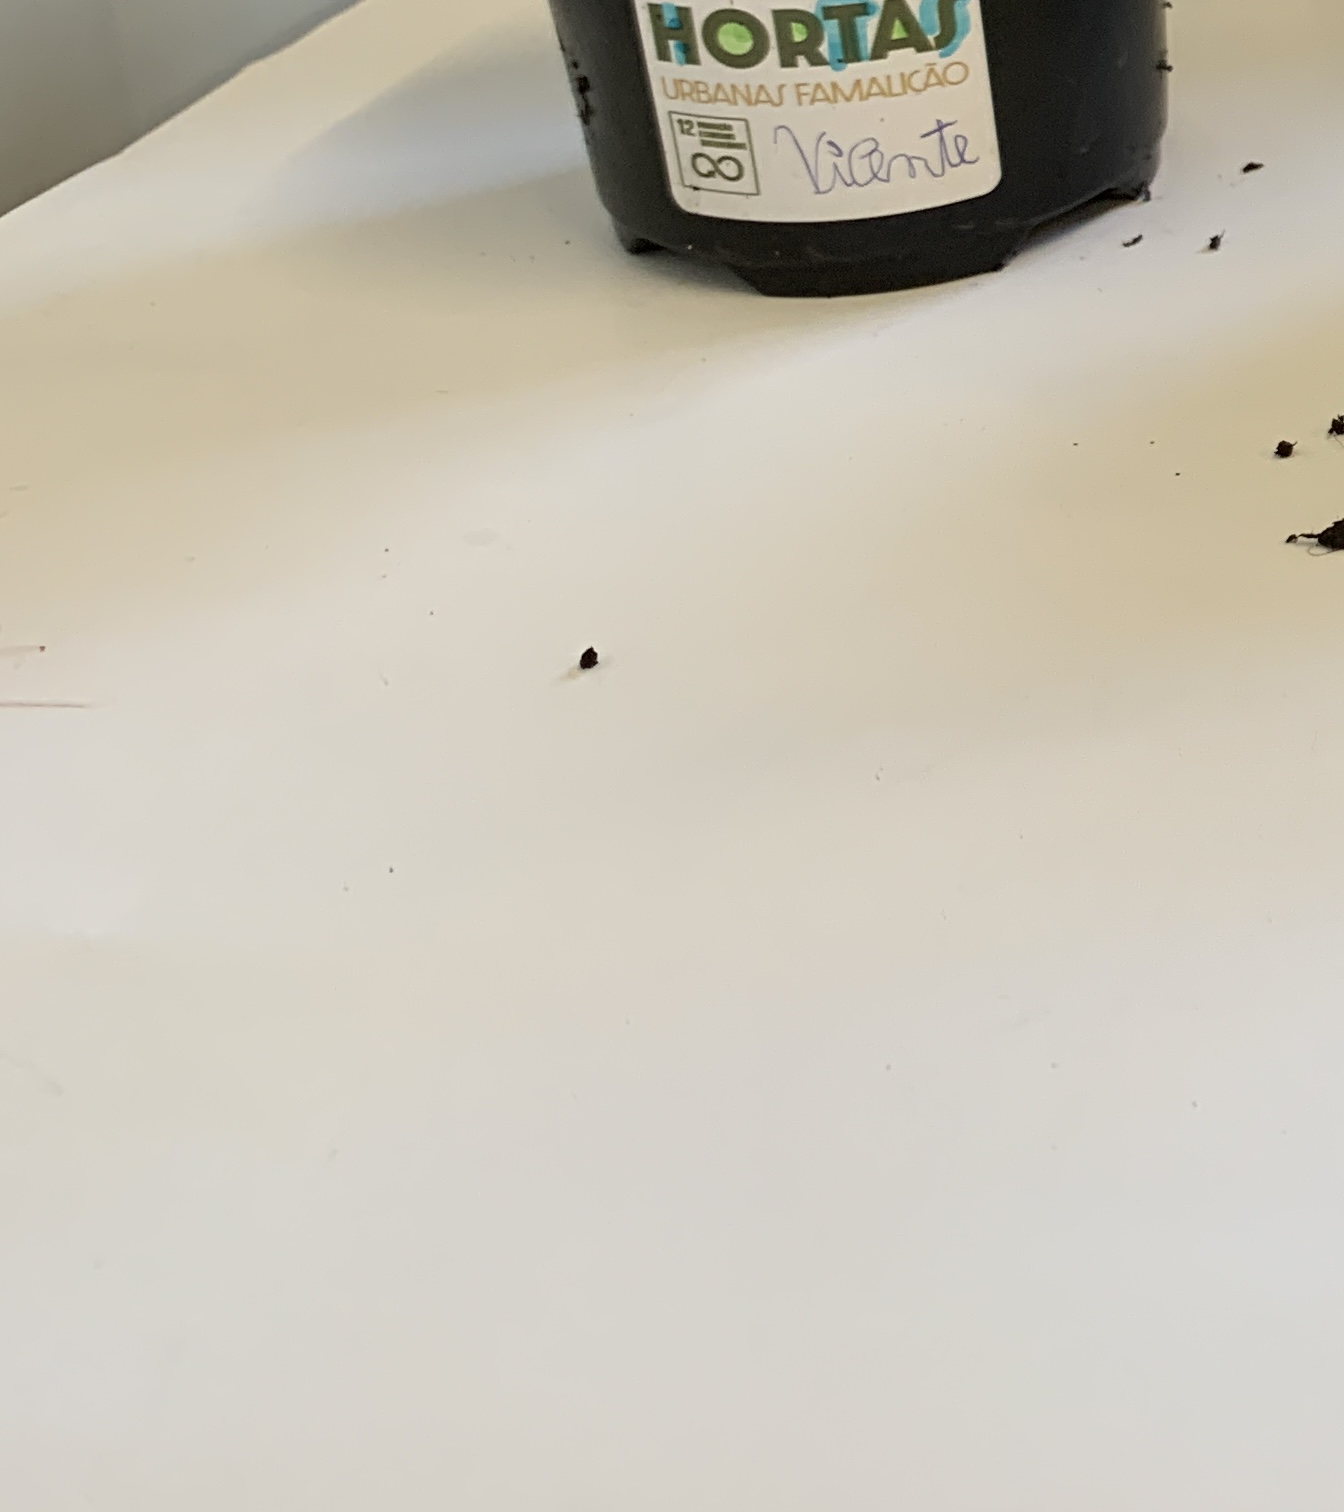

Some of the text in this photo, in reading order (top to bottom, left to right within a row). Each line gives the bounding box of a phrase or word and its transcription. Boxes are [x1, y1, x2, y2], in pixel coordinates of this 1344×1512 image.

[661, 62, 969, 108] URBANAS FAMALICÃO
[676, 118, 696, 137] 12
[774, 118, 981, 194] Vicente
